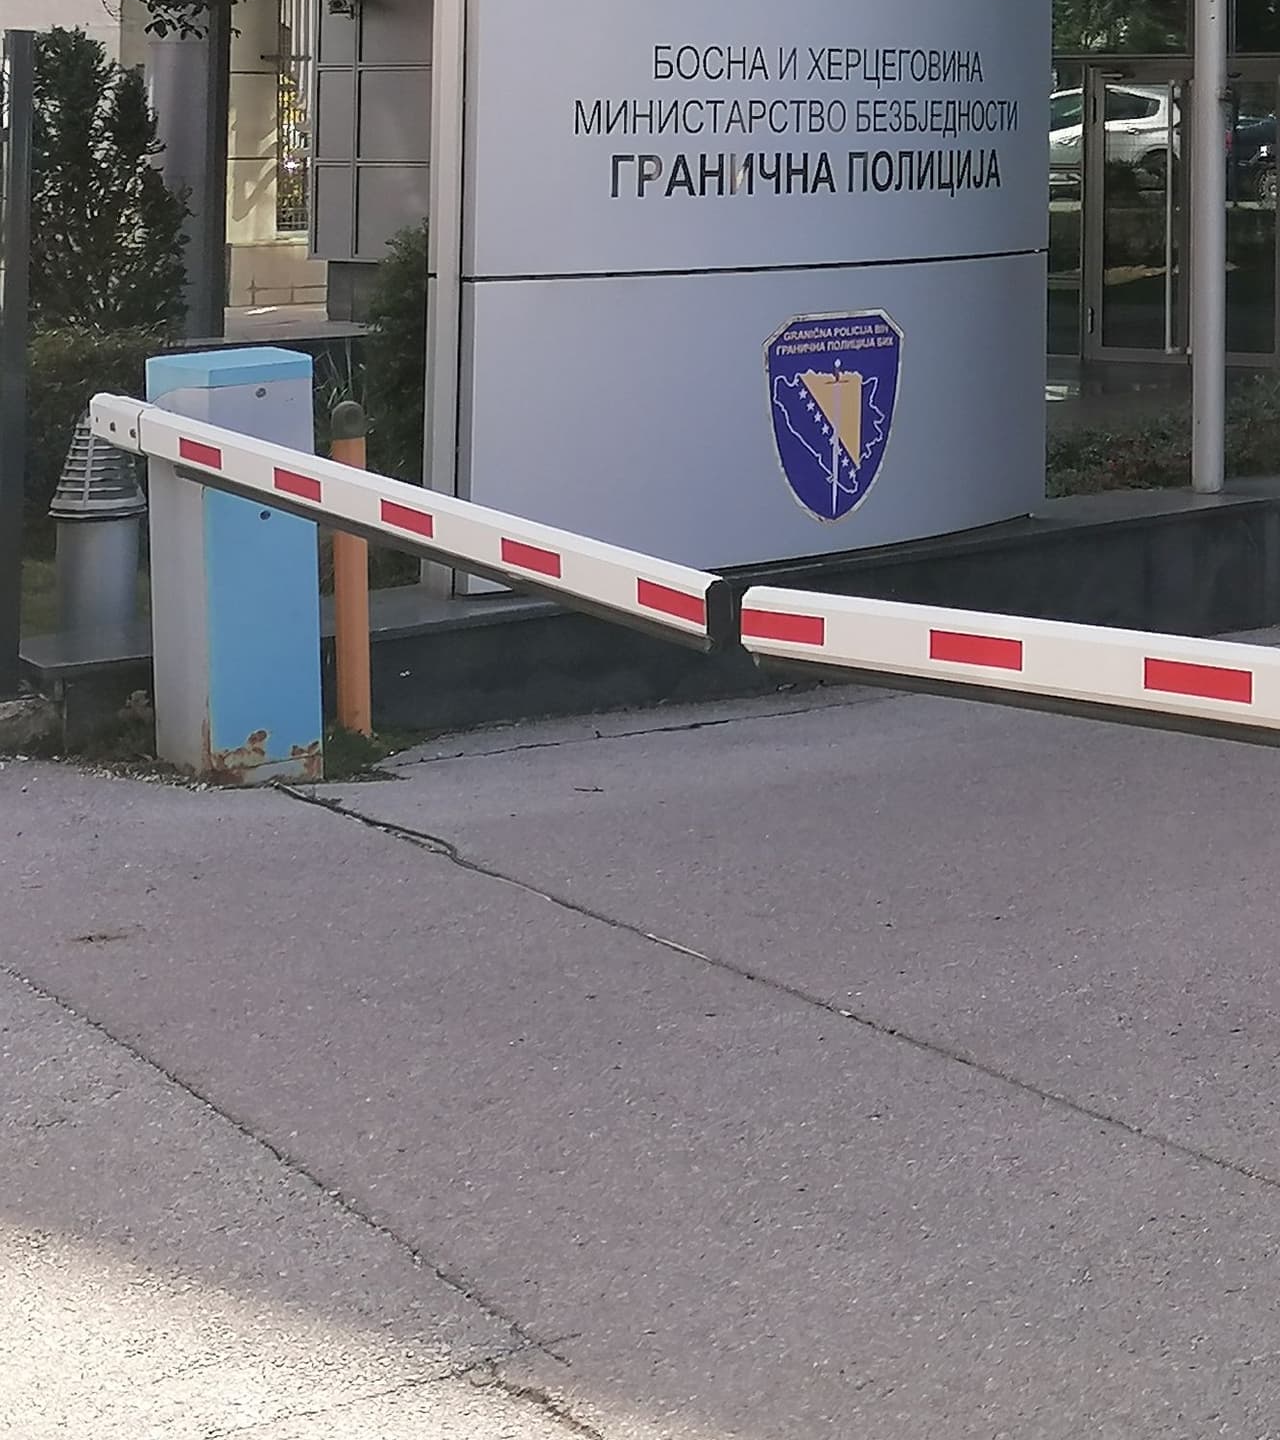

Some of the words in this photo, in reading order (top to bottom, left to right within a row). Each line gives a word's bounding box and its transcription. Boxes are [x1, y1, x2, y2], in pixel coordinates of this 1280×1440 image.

[653, 45, 769, 81] БОСНА
[778, 47, 798, 80] И
[807, 47, 983, 88] ХЕРЦЕГОВИНА
[573, 99, 847, 135] МИНИСТАРСТВО
[855, 99, 1018, 138] БЕЗБЈЕДНОСТИ
[610, 152, 837, 198] ГРАНИЧНА
[847, 149, 1001, 197] ПОЛИЦИЈА
